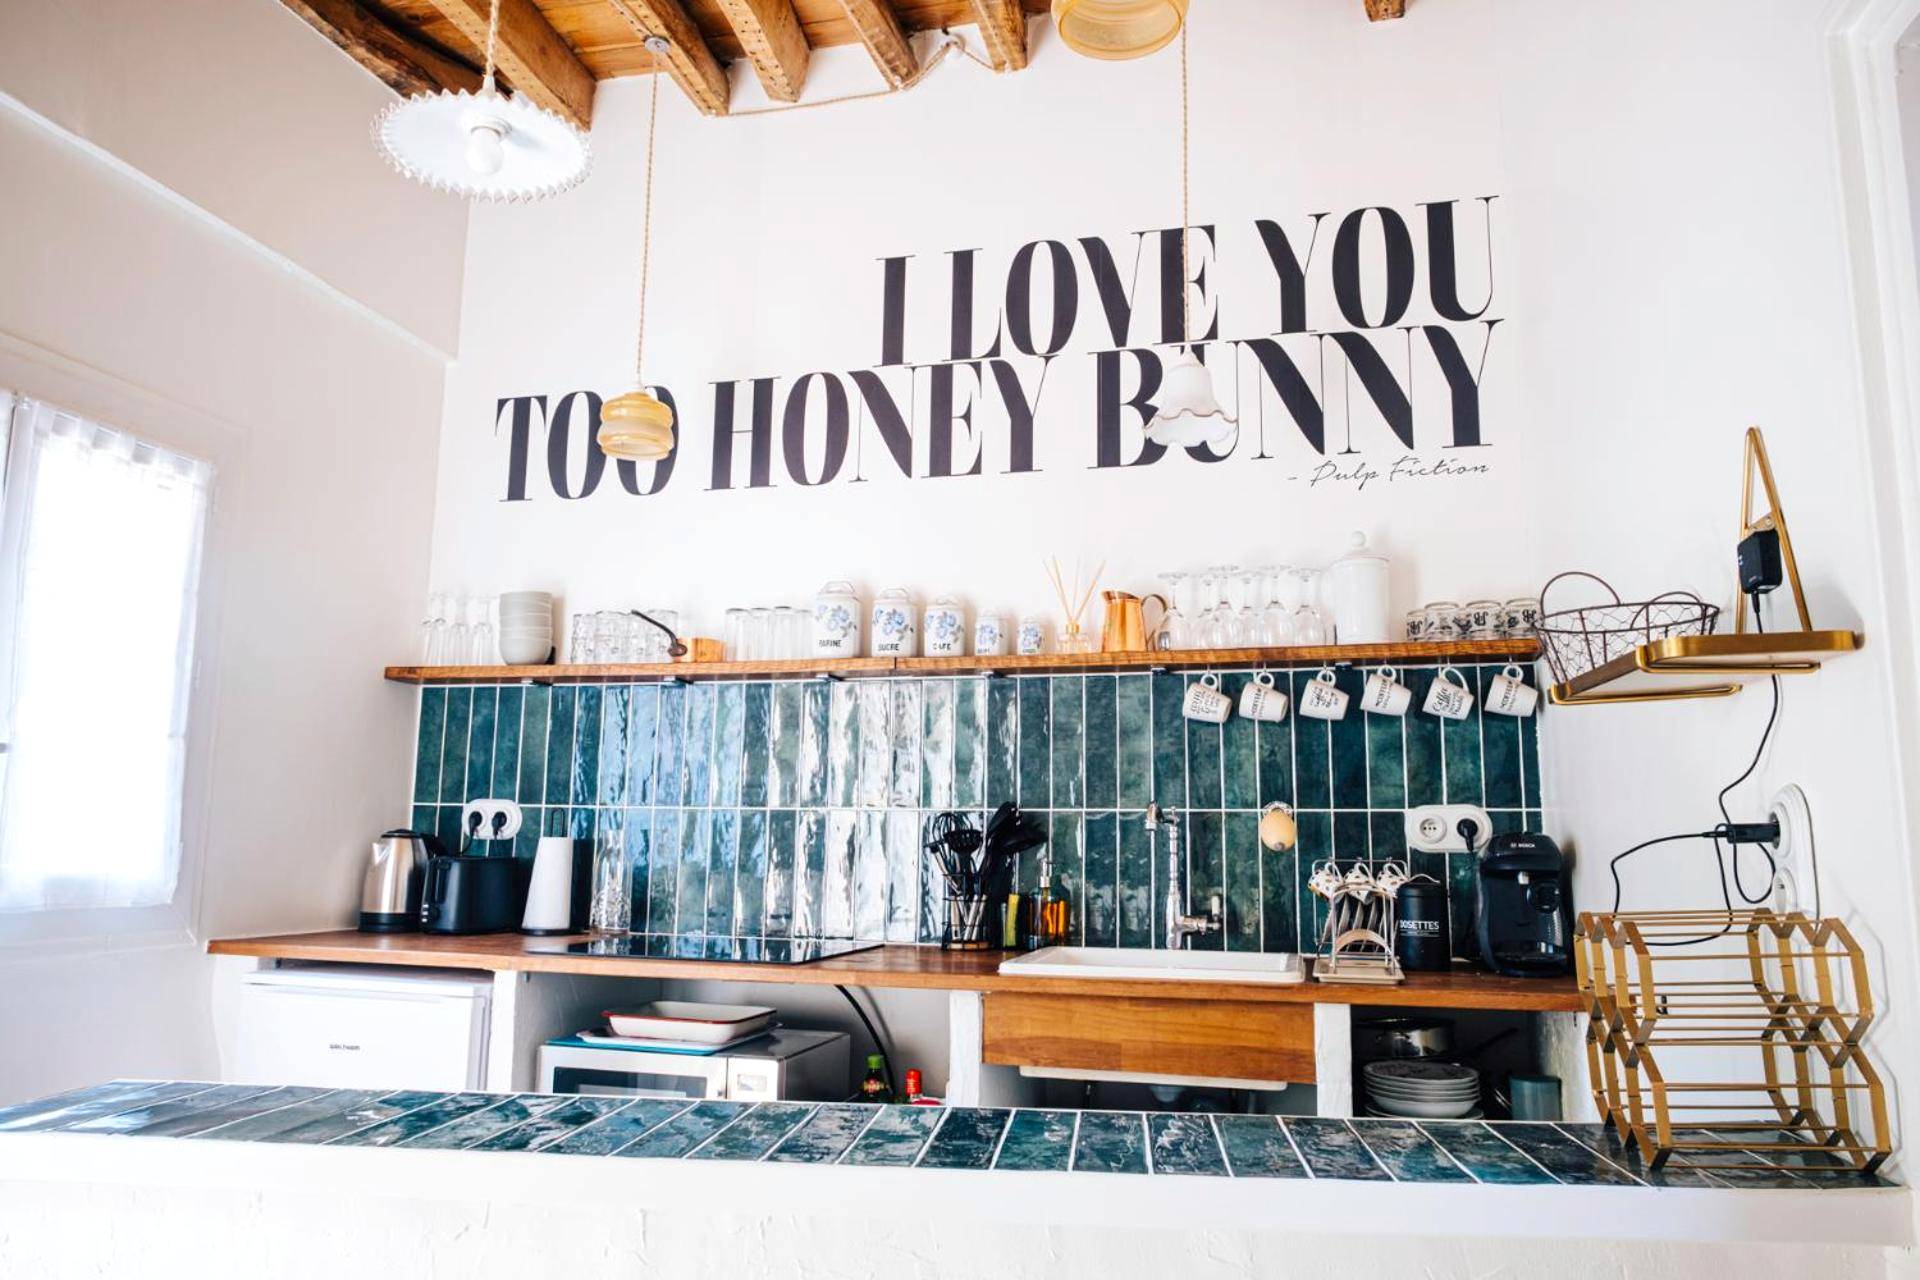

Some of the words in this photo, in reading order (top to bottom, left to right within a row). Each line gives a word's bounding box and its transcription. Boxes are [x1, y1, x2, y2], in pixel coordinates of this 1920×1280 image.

[875, 253, 916, 368] I
[942, 224, 1219, 362] LOVE
[1254, 195, 1500, 336] YOU
[703, 354, 1060, 491] HONEY
[1310, 459, 1380, 491] Pulp
[1389, 455, 1490, 482] Fiction
